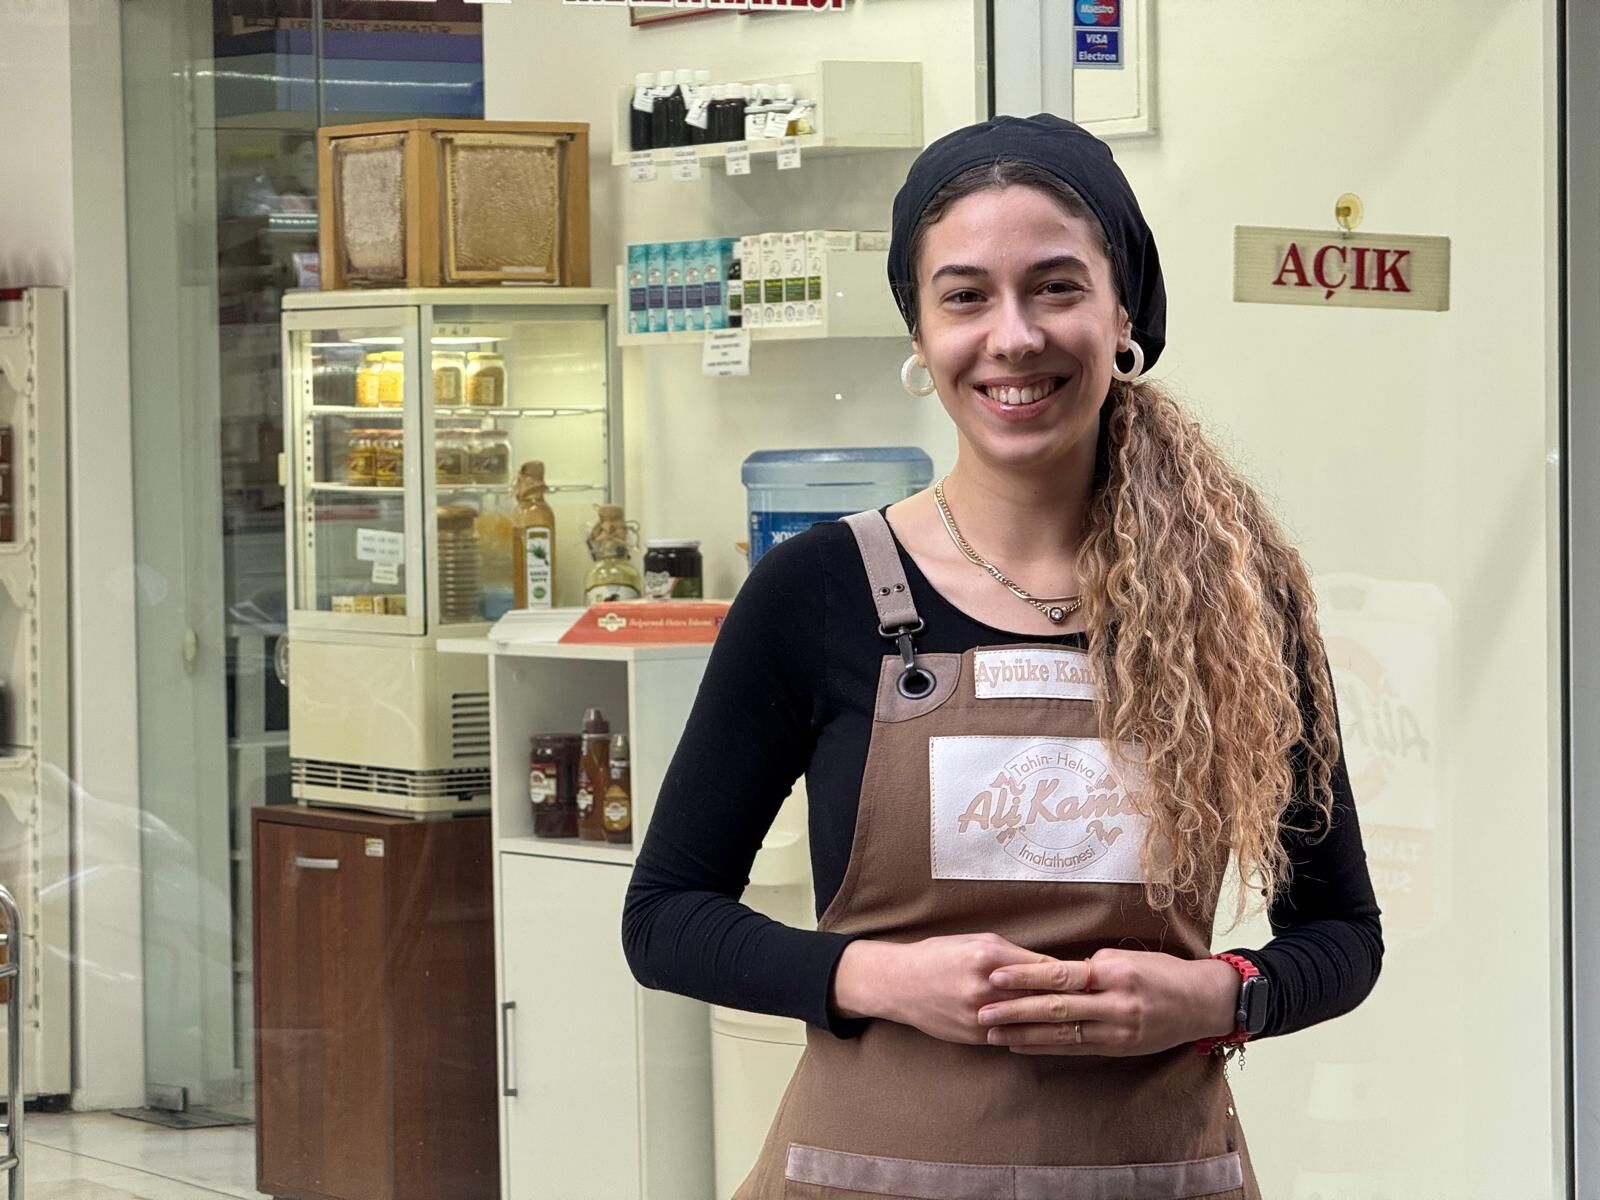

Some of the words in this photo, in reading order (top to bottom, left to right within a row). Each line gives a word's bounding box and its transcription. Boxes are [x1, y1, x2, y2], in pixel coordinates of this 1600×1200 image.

[1080, 4, 1114, 14] Maestro
[1086, 34, 1108, 44] VISA
[1079, 51, 1116, 61] Electron
[1272, 242, 1411, 300] AÇIK
[978, 658, 1050, 689] Aybüke
[1010, 752, 1054, 778] Tahin-
[1057, 752, 1096, 780] Helva
[958, 787, 1023, 833] Ali
